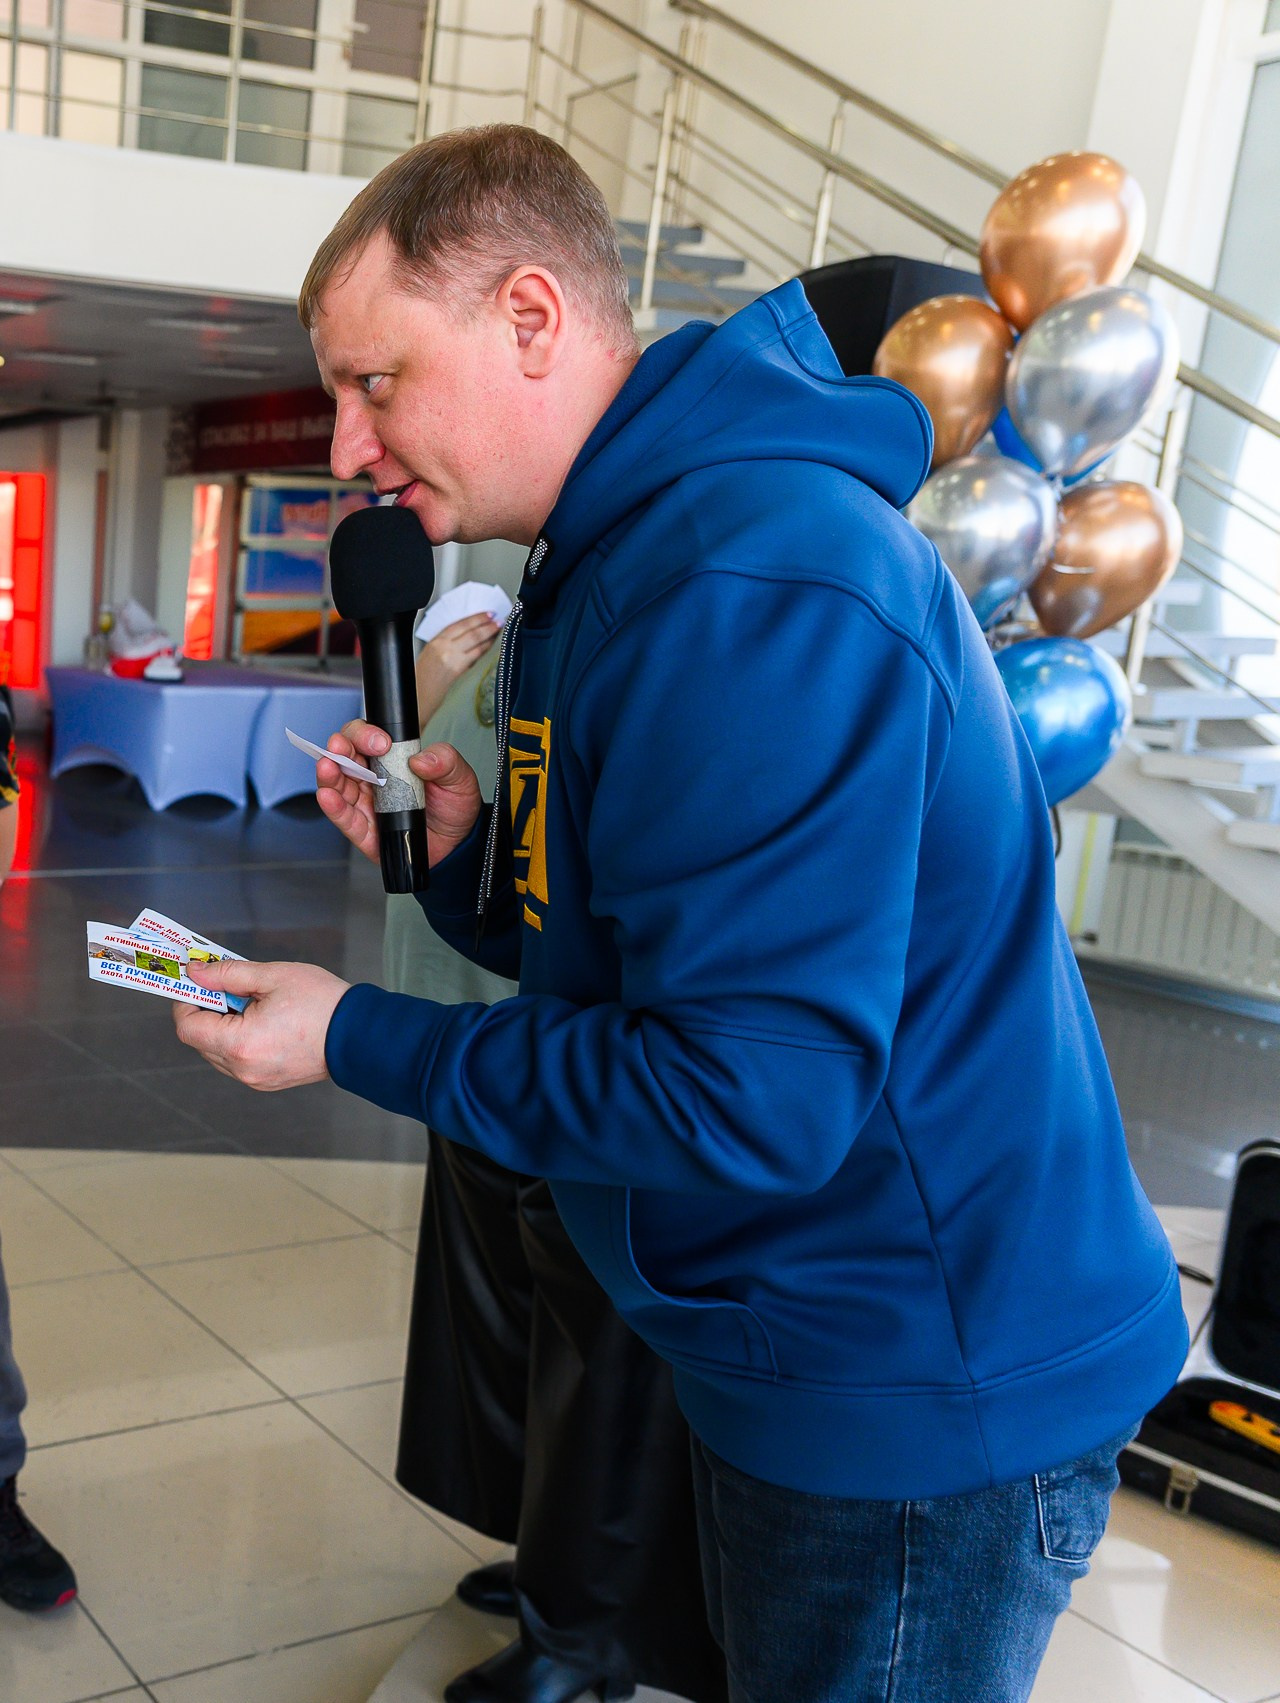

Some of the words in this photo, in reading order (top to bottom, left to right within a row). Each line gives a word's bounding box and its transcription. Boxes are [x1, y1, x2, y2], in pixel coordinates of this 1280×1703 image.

[104, 935, 150, 952] АКТИВНЫЙ
[152, 946, 181, 961] ОТДЫХ
[100, 961, 122, 972] ВСЕ
[125, 967, 170, 985] ЛУЧШЕЕ
[173, 981, 197, 993] ДЛЯ
[200, 988, 222, 1000] ВАС
[100, 969, 123, 979] ОХОТА
[125, 975, 160, 989] РЫБАЛКА
[162, 985, 191, 998] ТУРИЗМ
[192, 993, 223, 1007] ТЕХНИКА
